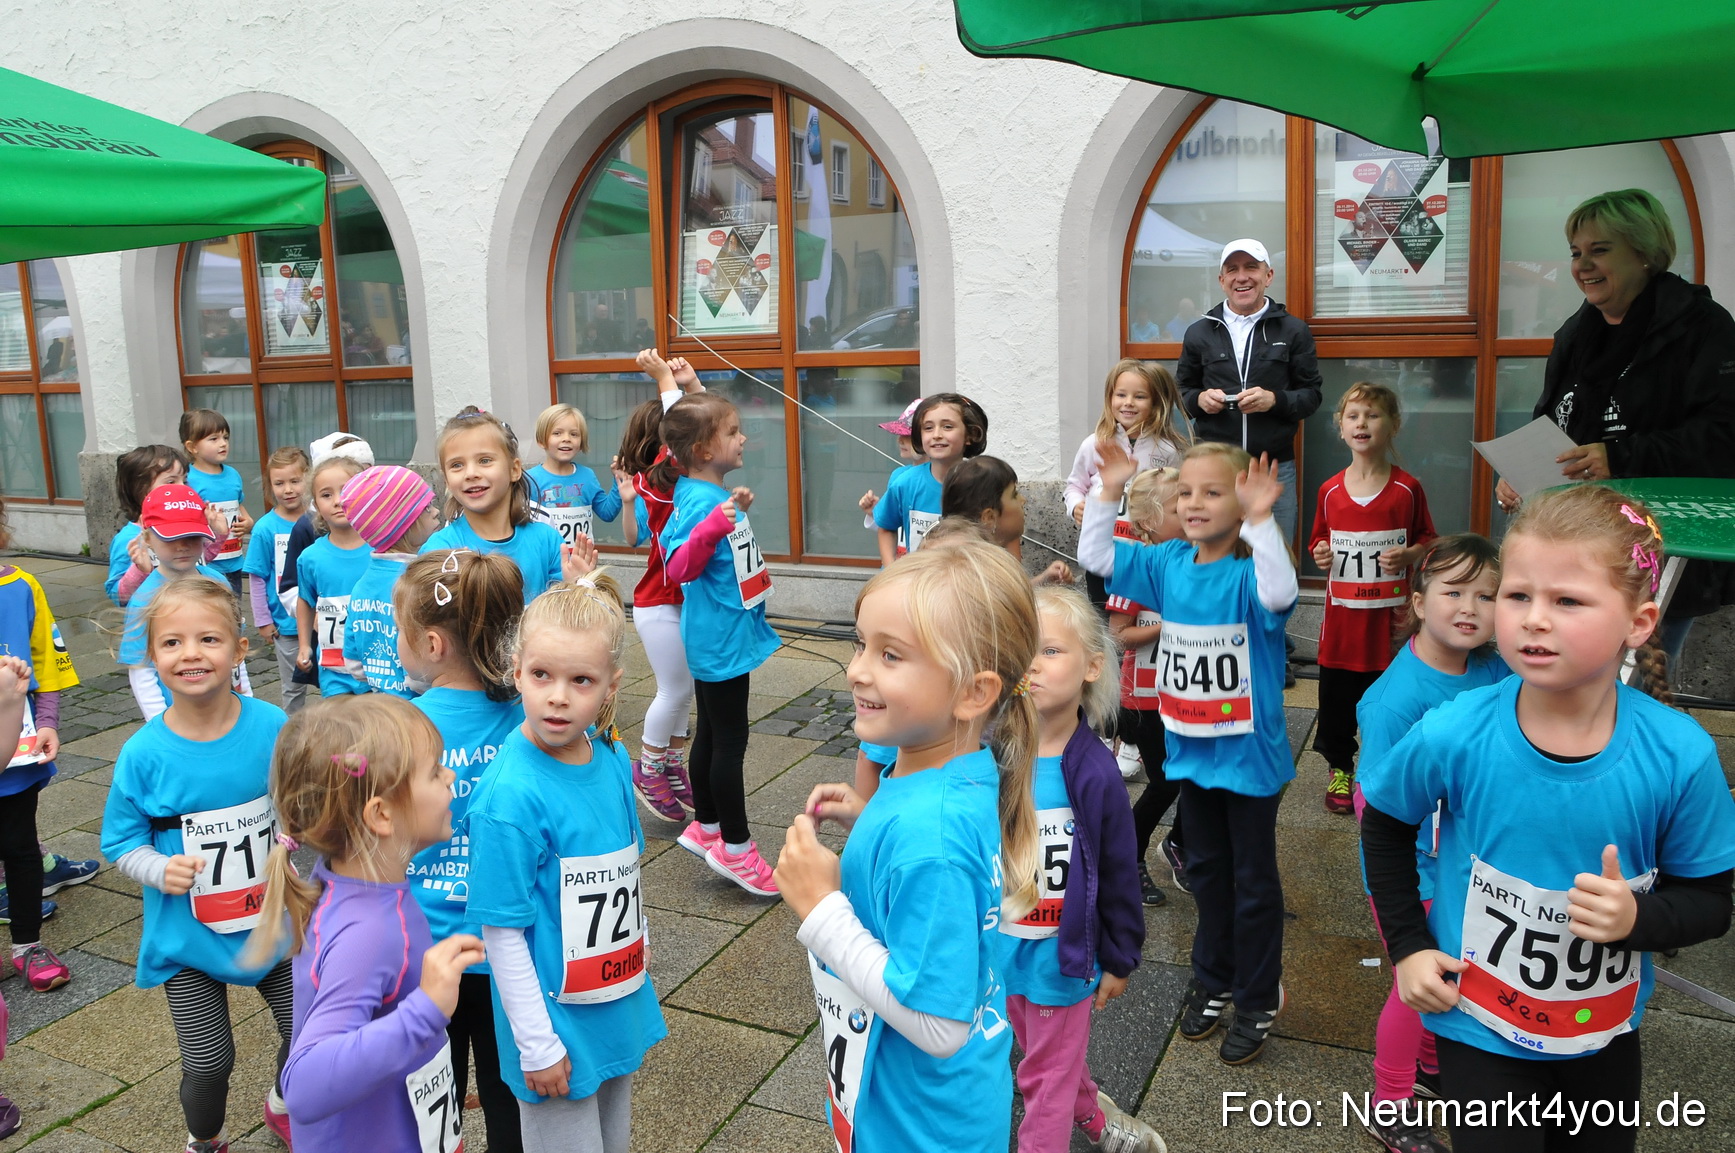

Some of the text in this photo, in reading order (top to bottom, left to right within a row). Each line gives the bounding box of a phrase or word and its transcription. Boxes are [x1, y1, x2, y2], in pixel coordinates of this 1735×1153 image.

[719, 209, 744, 222] JAZZ
[1354, 538, 1395, 547] Neumarkt
[1354, 586, 1381, 598] Jana
[1176, 635, 1226, 648] Neumarkt
[1162, 647, 1239, 694] 7540
[186, 821, 235, 837] PARTL
[564, 868, 616, 888] PARTL
[1472, 873, 1532, 919] PARTL
[414, 1064, 452, 1106] PARTL
